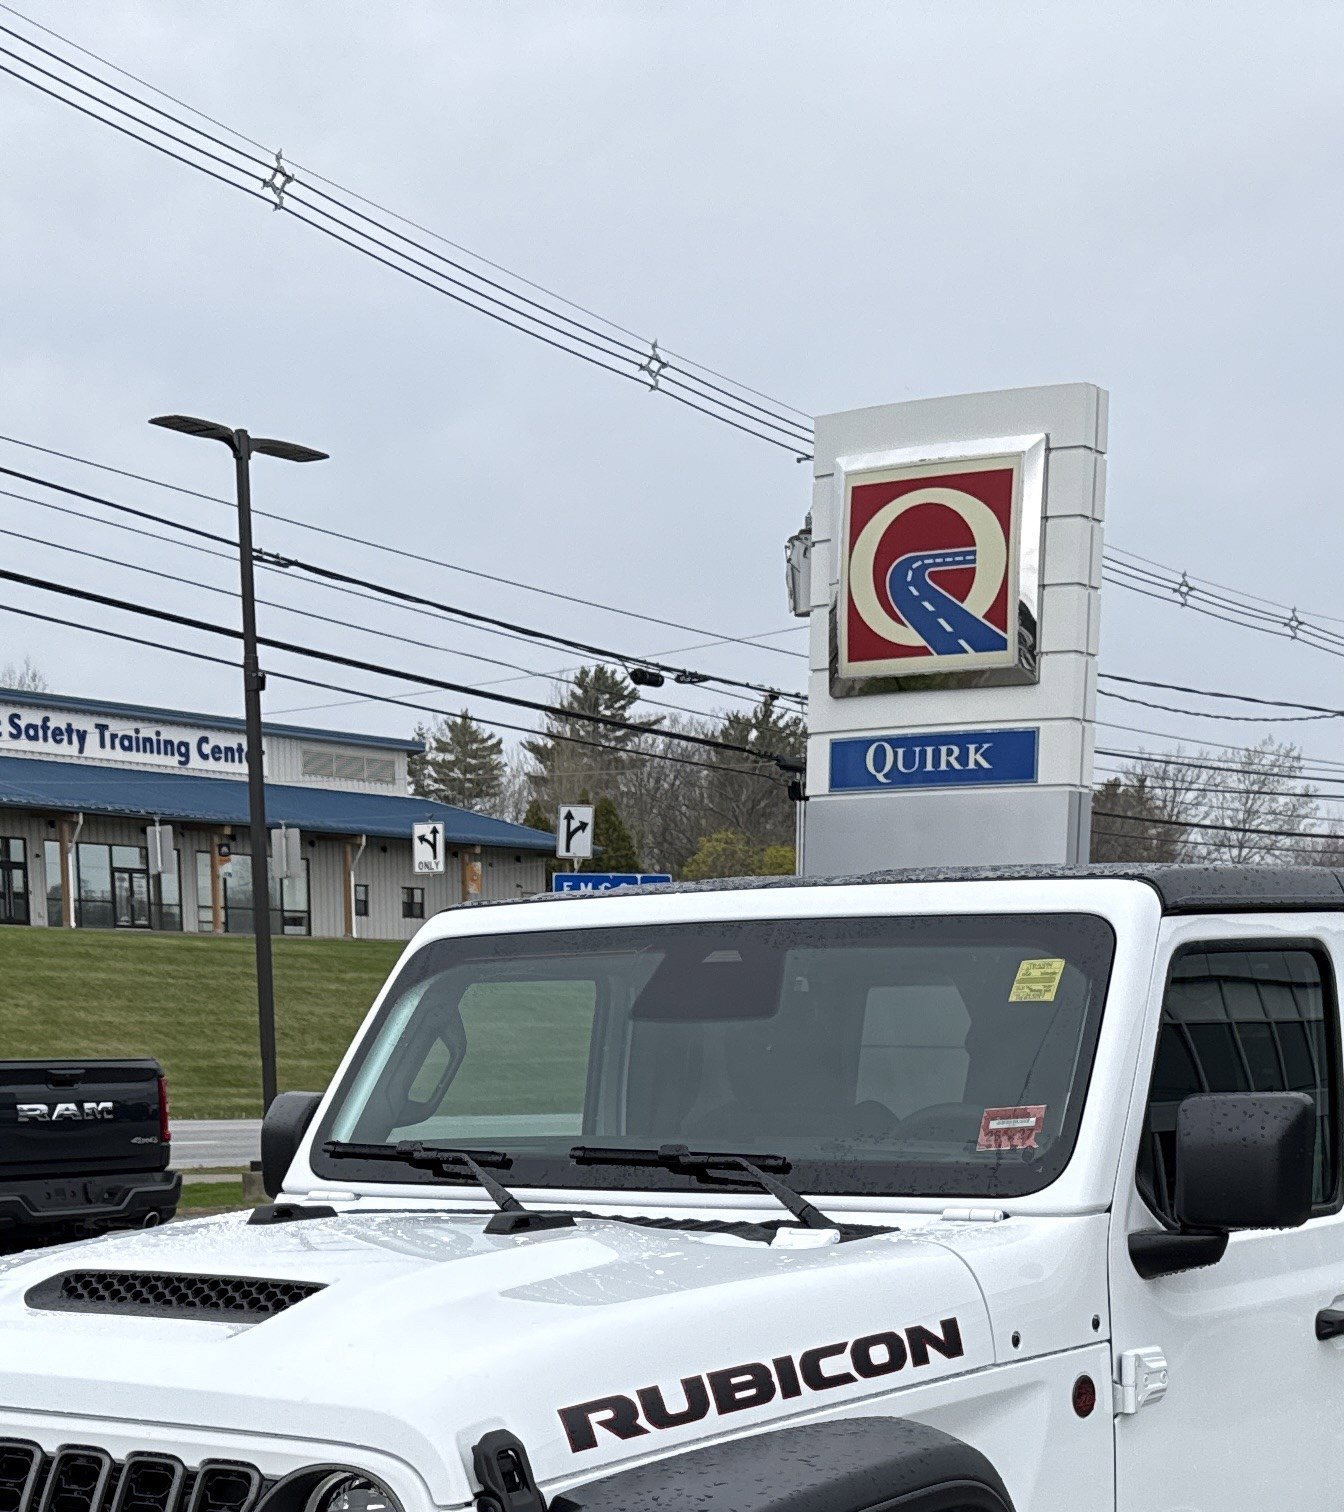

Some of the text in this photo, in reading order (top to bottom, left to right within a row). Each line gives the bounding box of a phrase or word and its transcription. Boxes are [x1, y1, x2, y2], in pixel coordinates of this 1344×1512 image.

[8, 713, 87, 754] Safety
[95, 723, 190, 766] Training
[197, 736, 249, 764] Cent
[865, 740, 993, 783] QUIRK
[418, 860, 440, 871] ONLY
[16, 1101, 115, 1123] RAM
[556, 1316, 965, 1455] RUBICON
